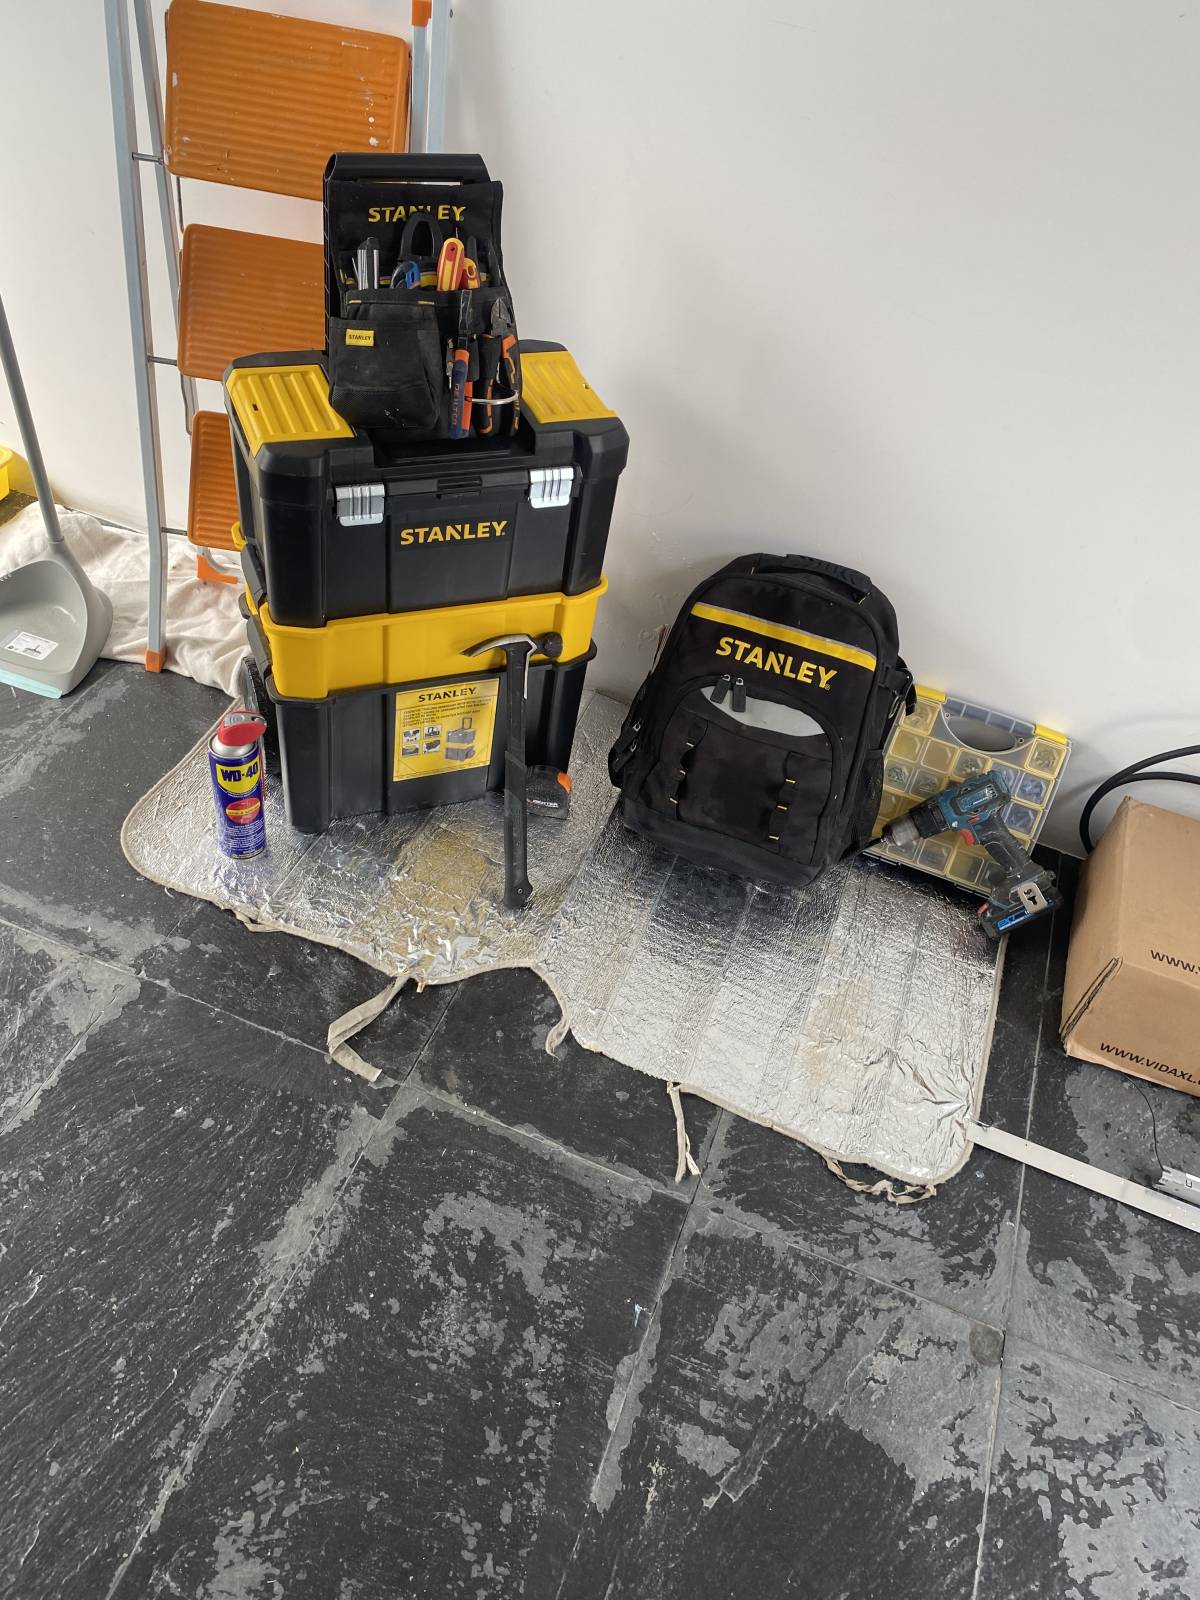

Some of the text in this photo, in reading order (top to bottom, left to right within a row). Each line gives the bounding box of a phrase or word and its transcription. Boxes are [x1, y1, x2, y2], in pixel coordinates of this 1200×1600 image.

[400, 520, 507, 545] STANLEY
[715, 636, 837, 689] STANLEY
[418, 687, 476, 702] STANLEY
[220, 761, 259, 782] WD-40
